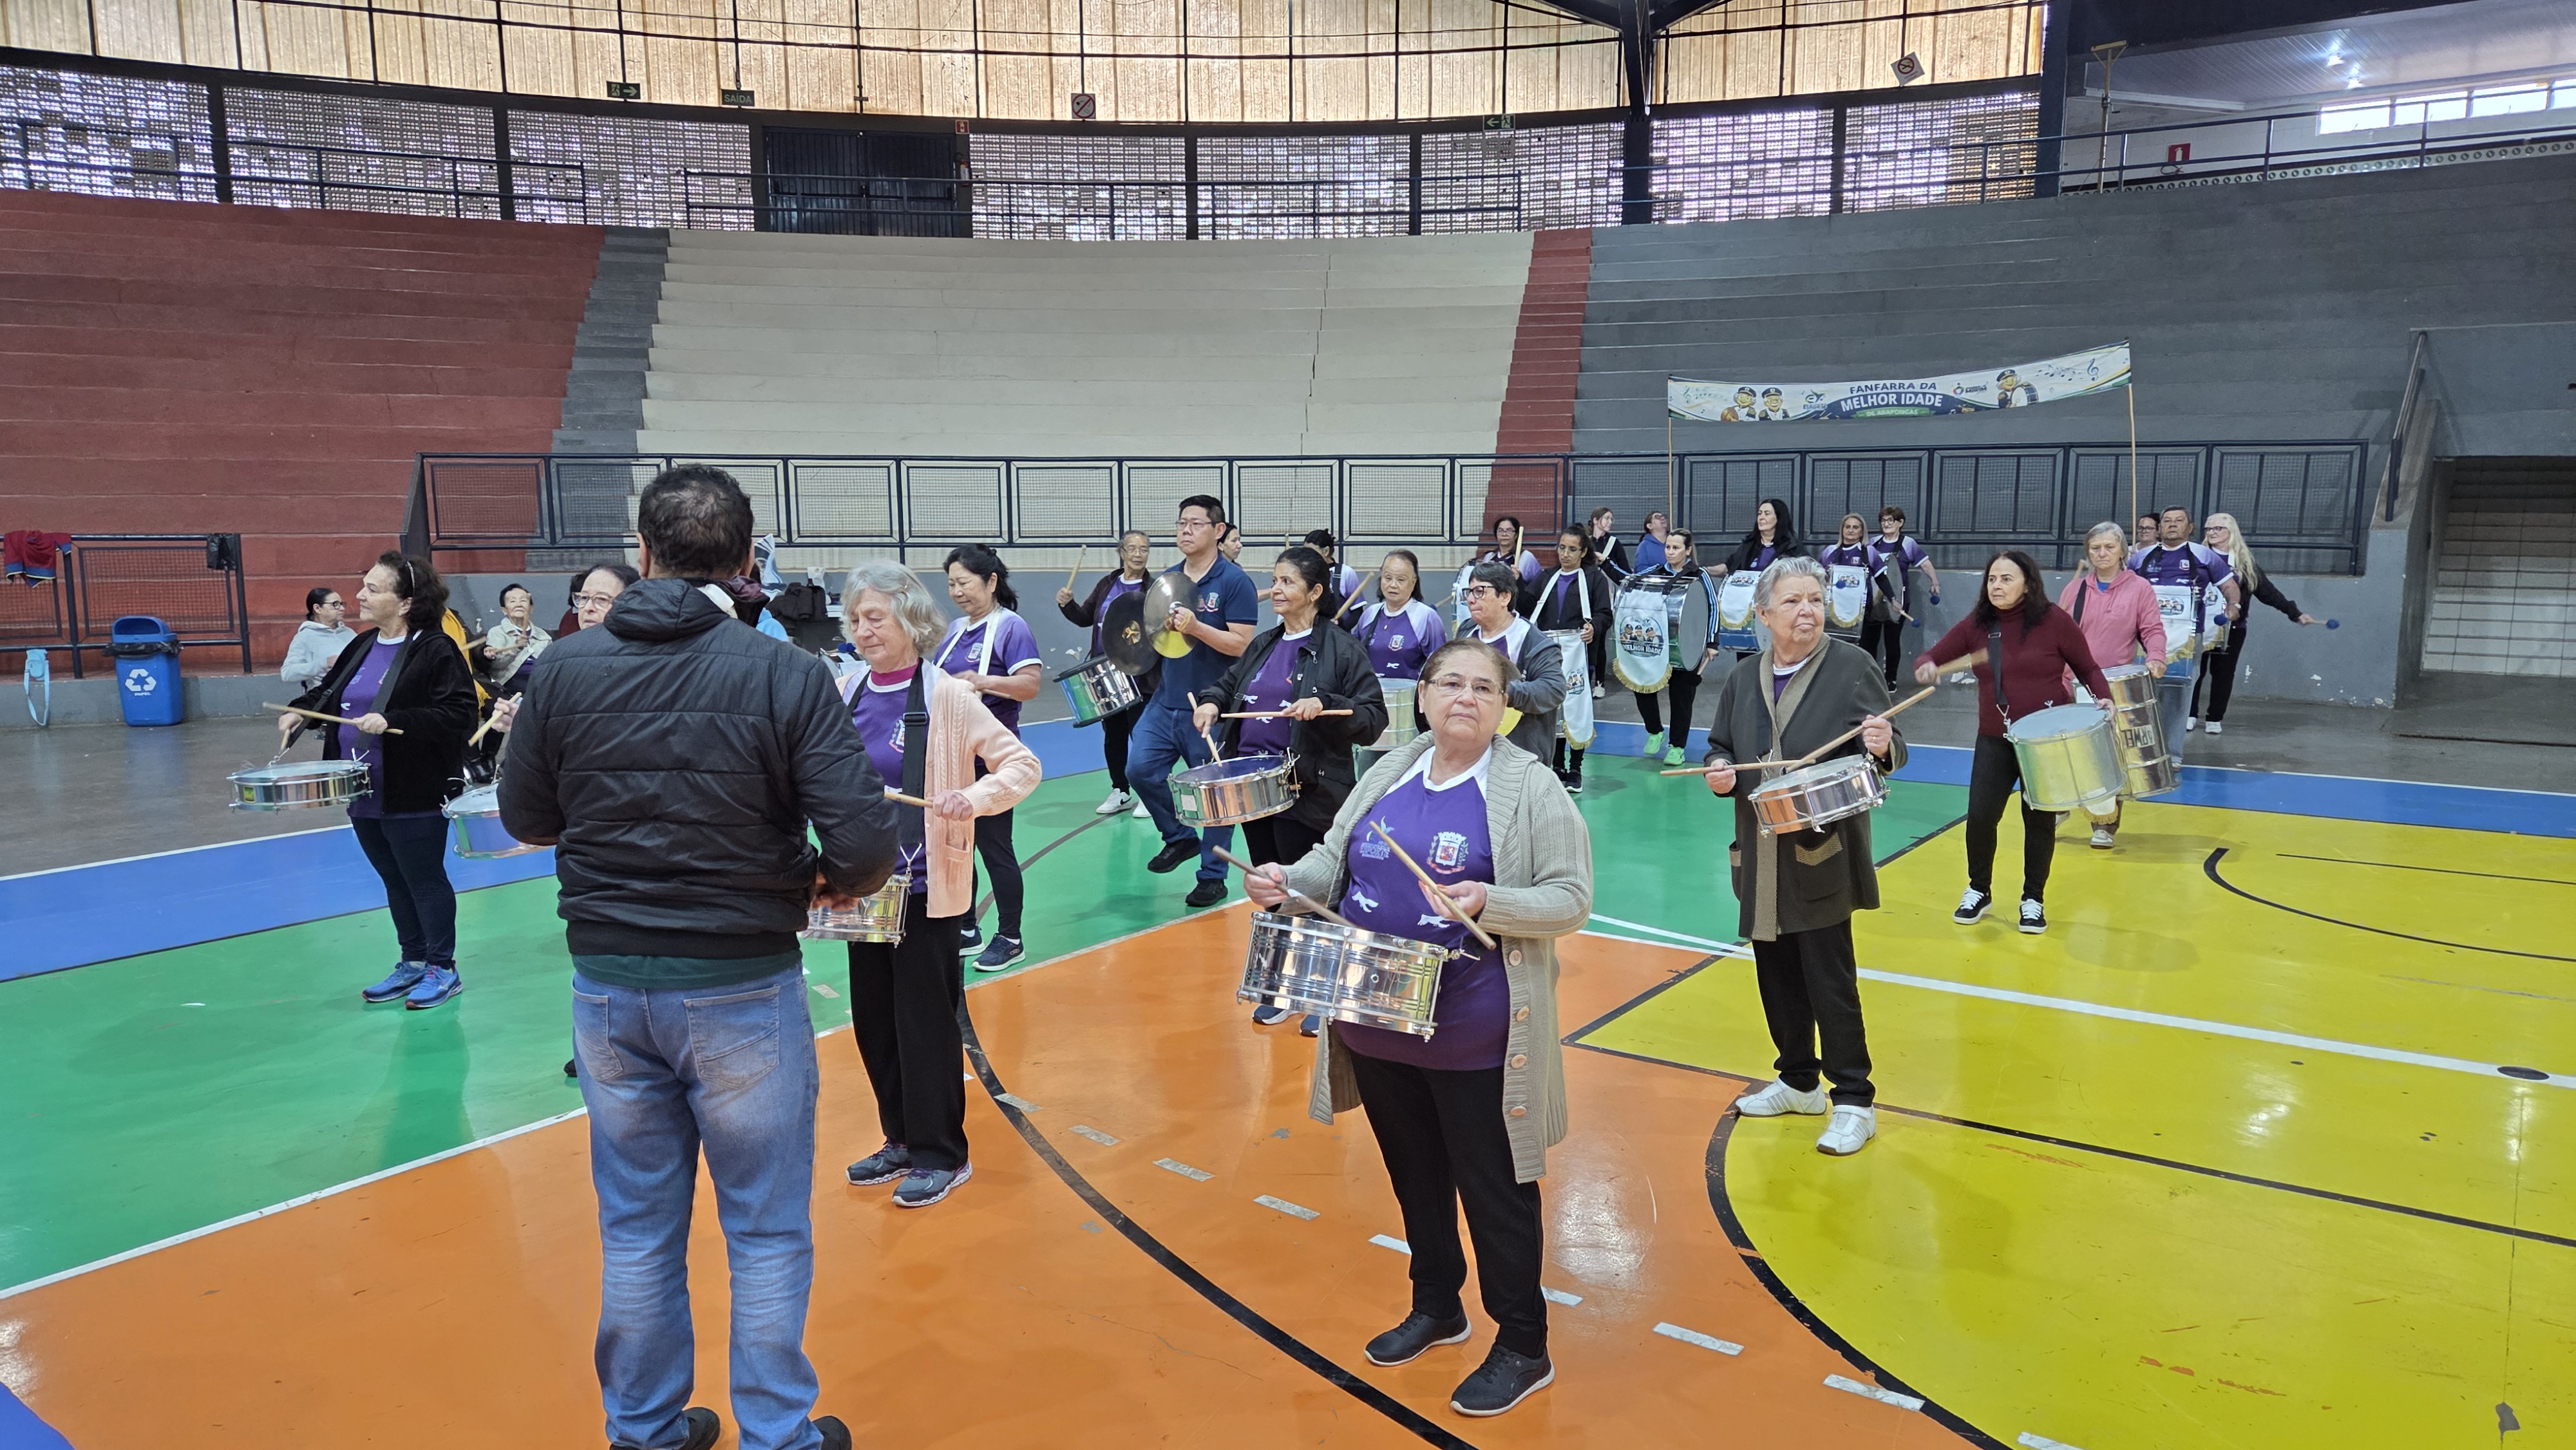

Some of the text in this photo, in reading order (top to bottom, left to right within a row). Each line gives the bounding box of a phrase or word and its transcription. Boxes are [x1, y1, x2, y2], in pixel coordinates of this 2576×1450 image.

[724, 92, 752, 103] SAÍDA
[1850, 382, 1915, 394] FANFARRA
[1841, 393, 1897, 412] MELHOR
[1901, 394, 1943, 407] IDADE
